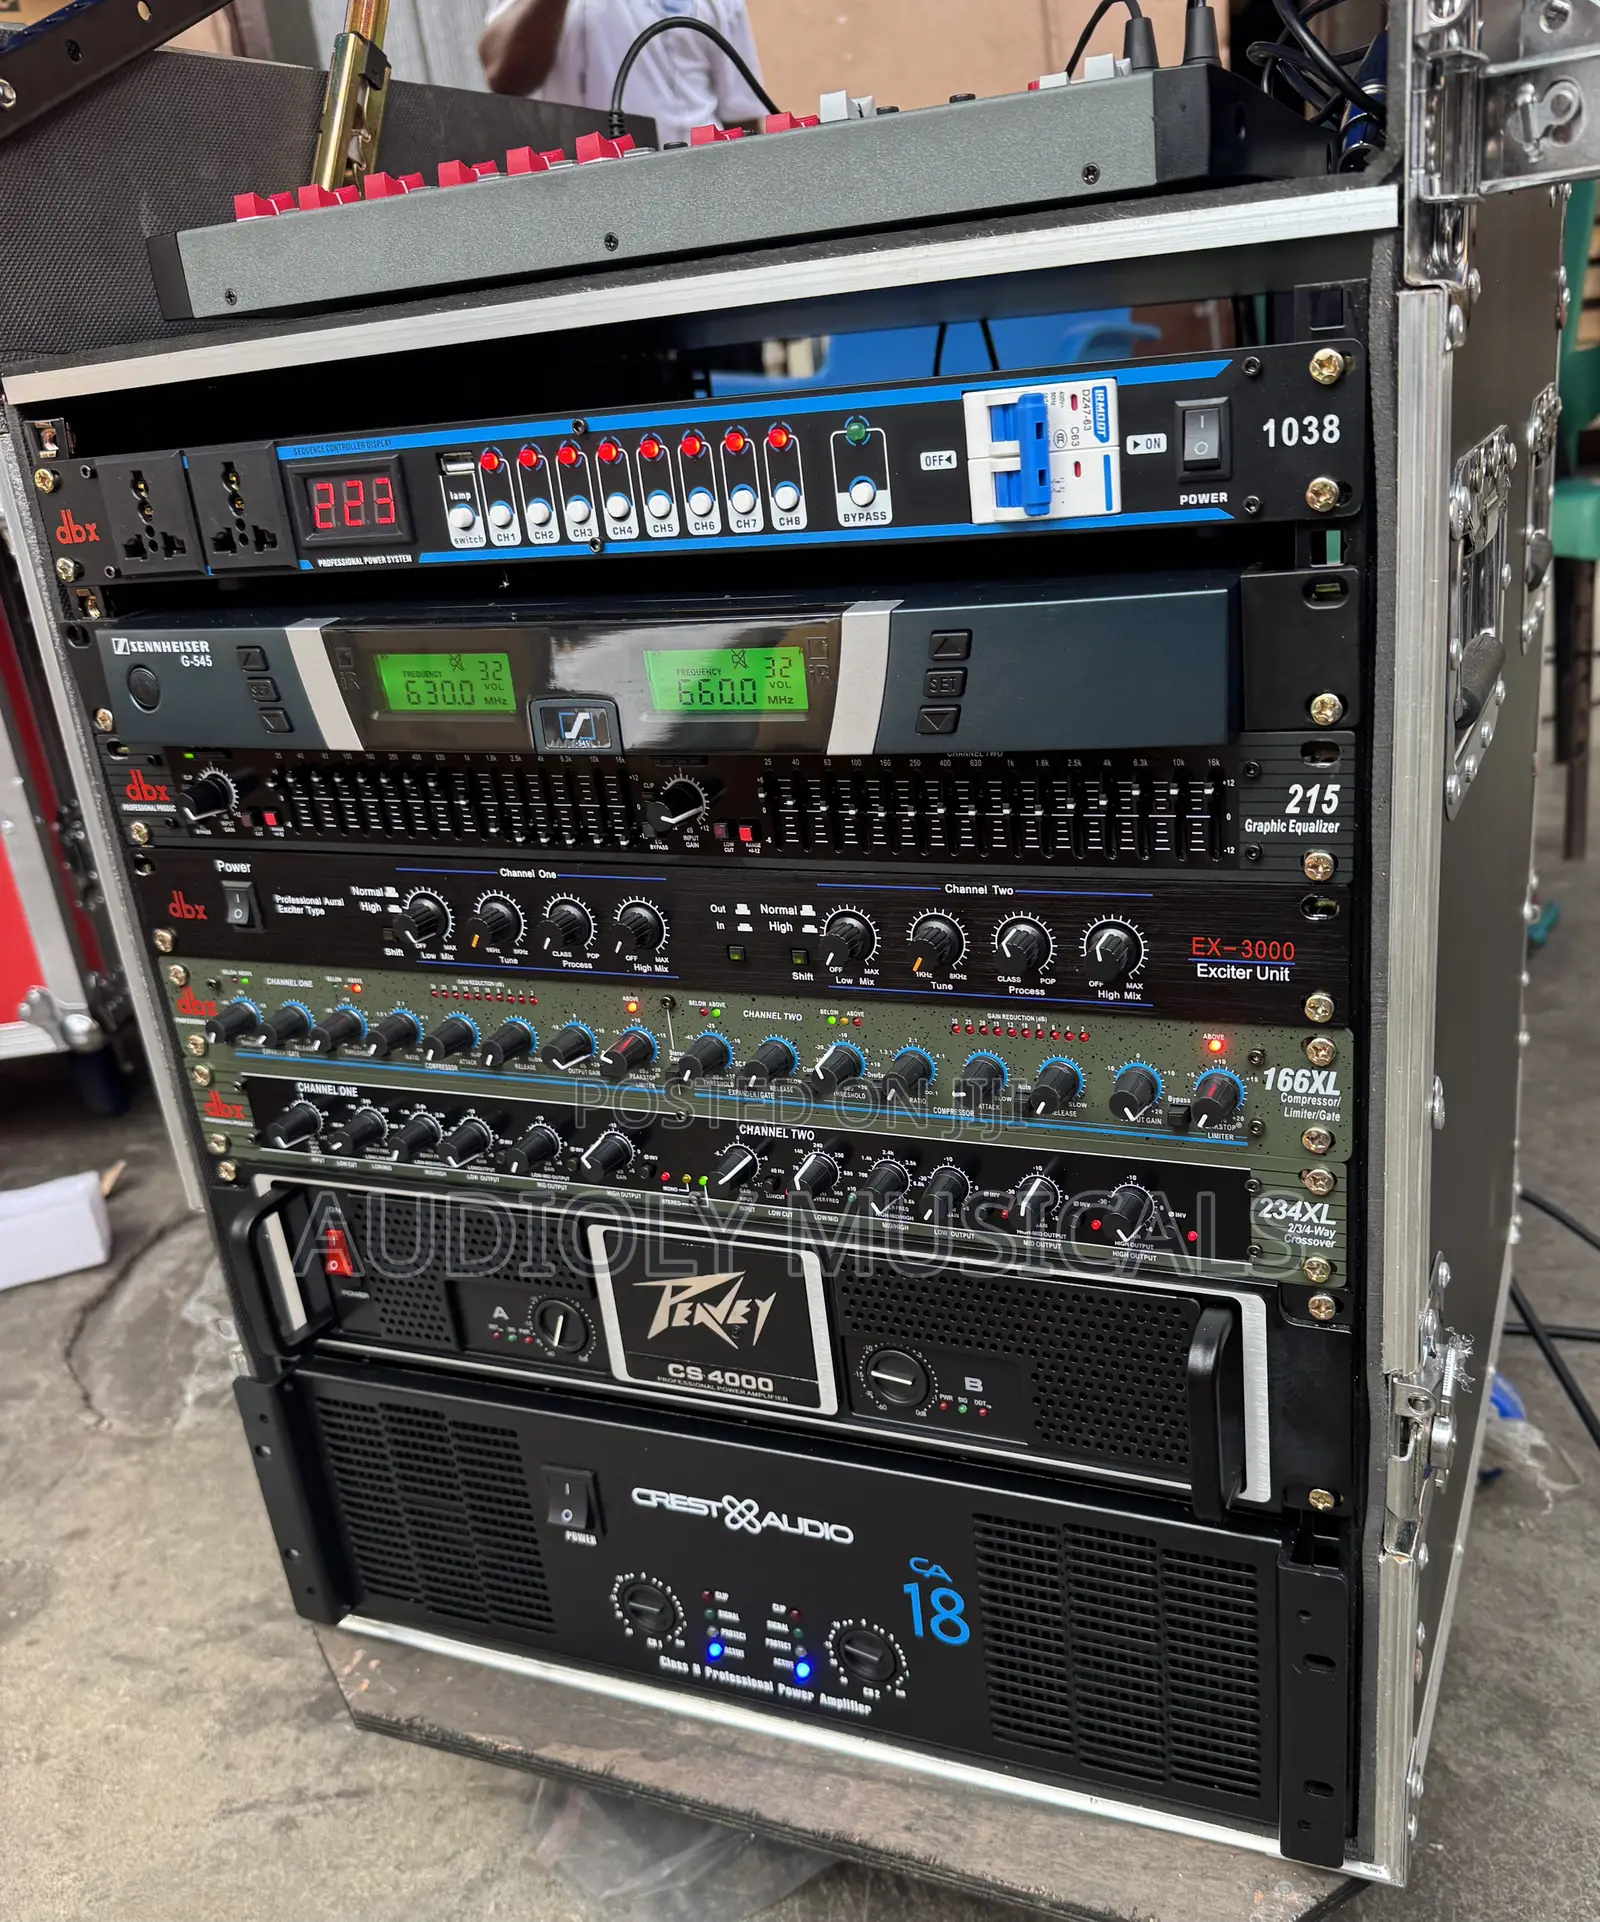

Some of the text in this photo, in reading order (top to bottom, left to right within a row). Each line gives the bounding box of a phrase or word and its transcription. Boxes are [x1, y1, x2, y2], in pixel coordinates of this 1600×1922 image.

[1070, 426, 1080, 447] C63
[1262, 413, 1341, 448] 1038
[293, 440, 393, 456] SEQUENCE CONTROLLER DISPLAY
[1145, 437, 1161, 450] ON
[924, 455, 945, 467] OFF
[449, 490, 472, 502] lamp
[1179, 492, 1229, 506] POWER
[314, 477, 396, 529] 223
[778, 515, 801, 527] CH8
[843, 511, 888, 523] BYPASS
[55, 508, 101, 545] dbx
[652, 523, 674, 534] CH5
[693, 520, 716, 532] CH6
[735, 518, 758, 530] CH7
[534, 530, 555, 541] CH2
[572, 527, 594, 539] CH3
[611, 525, 634, 537] CH4
[453, 533, 485, 545] switch
[496, 533, 517, 543] CH1
[317, 553, 413, 568] PROFESSIONAL POWER SYSTEM
[129, 639, 211, 653] SENNHEISER
[179, 654, 213, 668] G-545
[764, 656, 792, 678] 32
[402, 670, 443, 678] FREQUENCY
[478, 660, 503, 681] 32
[676, 667, 722, 677] FREQUENCY
[484, 683, 505, 691] VOL
[769, 681, 792, 689] VOL
[930, 678, 956, 693] SET
[405, 680, 476, 706] 630.0
[678, 678, 757, 706] 660.0
[484, 696, 508, 706] MHz
[767, 695, 795, 705] MHz
[1067, 759, 1083, 767] 2.5k
[1102, 759, 1112, 767] 4k
[1133, 758, 1149, 768] 6.3k
[125, 768, 171, 802] dbx
[1284, 783, 1342, 815] 215
[1244, 818, 1341, 836] Graphic Equalizer
[214, 859, 251, 874] Power
[500, 867, 557, 880] Channel One
[350, 885, 384, 898] Normal
[944, 883, 1014, 896] Channel Two
[168, 889, 208, 921] dbx
[273, 894, 345, 908] Professional Aural
[275, 904, 326, 917] Exciter Type
[358, 901, 382, 914] High
[709, 903, 727, 914] Out
[759, 903, 798, 916] Normal
[715, 920, 725, 930] In
[768, 920, 794, 935] High
[383, 947, 405, 957] Shift
[552, 950, 573, 959] CLASS
[1190, 936, 1296, 961] EX-3000
[420, 951, 455, 961] Low Mix
[498, 955, 519, 965] Tune
[625, 954, 639, 962] OFF
[654, 955, 670, 964] MAX
[562, 959, 594, 970] Process
[633, 963, 670, 975] High Mix
[829, 966, 843, 974] OFF
[791, 971, 815, 982] Shift
[863, 968, 880, 976] MAX
[915, 970, 933, 979] 1KHz
[1196, 962, 1291, 982] Exciter Unit
[266, 977, 314, 989] CHANNEL ONE
[835, 975, 875, 987] Low Mix
[930, 980, 954, 991] Tune
[996, 975, 1022, 984] CLASS
[1039, 977, 1057, 986] POP
[1008, 985, 1046, 997] Process
[1125, 982, 1144, 990] MAX
[176, 985, 219, 1017] dbx
[622, 995, 639, 1003] ABOVE
[1097, 989, 1142, 1002] High Mix
[743, 1009, 803, 1022] CHANNEL TWO
[820, 1008, 839, 1016] BELOW
[846, 1010, 865, 1018] ABOVE
[987, 1012, 1001, 1021] GAIN
[1001, 1013, 1036, 1023] REDUCTION
[1202, 1033, 1225, 1041] ABOVE
[424, 1061, 459, 1072] COMPRESSOR
[1017, 1083, 1031, 1091] Auto
[1263, 1066, 1341, 1097] 166XL
[297, 1081, 359, 1098] CHANNEL ONE
[769, 1085, 794, 1094] RELEASE
[203, 1089, 246, 1120] dbx
[1167, 1095, 1191, 1104] Bypass
[1280, 1092, 1342, 1108] Compressor/
[933, 1106, 975, 1118] COMPRESSOR
[978, 1103, 1001, 1111] ATTACK
[1283, 1106, 1341, 1122] Limiter/Gate
[1146, 1117, 1163, 1125] GAIN
[739, 1123, 816, 1142] CHANNEL TWO
[1207, 1132, 1235, 1141] LIMITER
[466, 1173, 501, 1183] LOW OUTPUT
[547, 1183, 568, 1191] OUTPUT
[662, 1185, 679, 1193] MONO
[620, 1191, 642, 1200] OUTPUT
[661, 1199, 682, 1207] STEREO
[768, 1209, 794, 1219] LOW CUT
[1257, 1197, 1337, 1226] 234XL
[933, 1228, 976, 1240] LOW OUTPUT
[1287, 1222, 1337, 1239] 2/3/4-Way
[1023, 1239, 1063, 1251] MID OUTPUT
[1129, 1242, 1154, 1251] OUTPUT
[1283, 1233, 1336, 1249] Crossover
[1112, 1250, 1158, 1263] HIGH OUTPUT
[492, 1306, 510, 1321] A
[632, 1270, 778, 1350] PEAVEY
[667, 1362, 775, 1393] CS 4000
[656, 1375, 790, 1403] PROFESSIONAL POWER AMPLIFIER
[963, 1376, 984, 1393] B
[939, 1393, 954, 1402] PWR
[631, 1487, 855, 1545] CREST AUDIO
[564, 1529, 598, 1546] POWER
[908, 1556, 953, 1584] CA
[714, 1590, 730, 1603] CLIP
[771, 1602, 787, 1615] CLIP
[902, 1581, 971, 1647] 18
[658, 1653, 690, 1675] Class
[704, 1664, 775, 1696] Professional
[777, 1680, 815, 1703] Power
[818, 1691, 873, 1718] Amplifier
